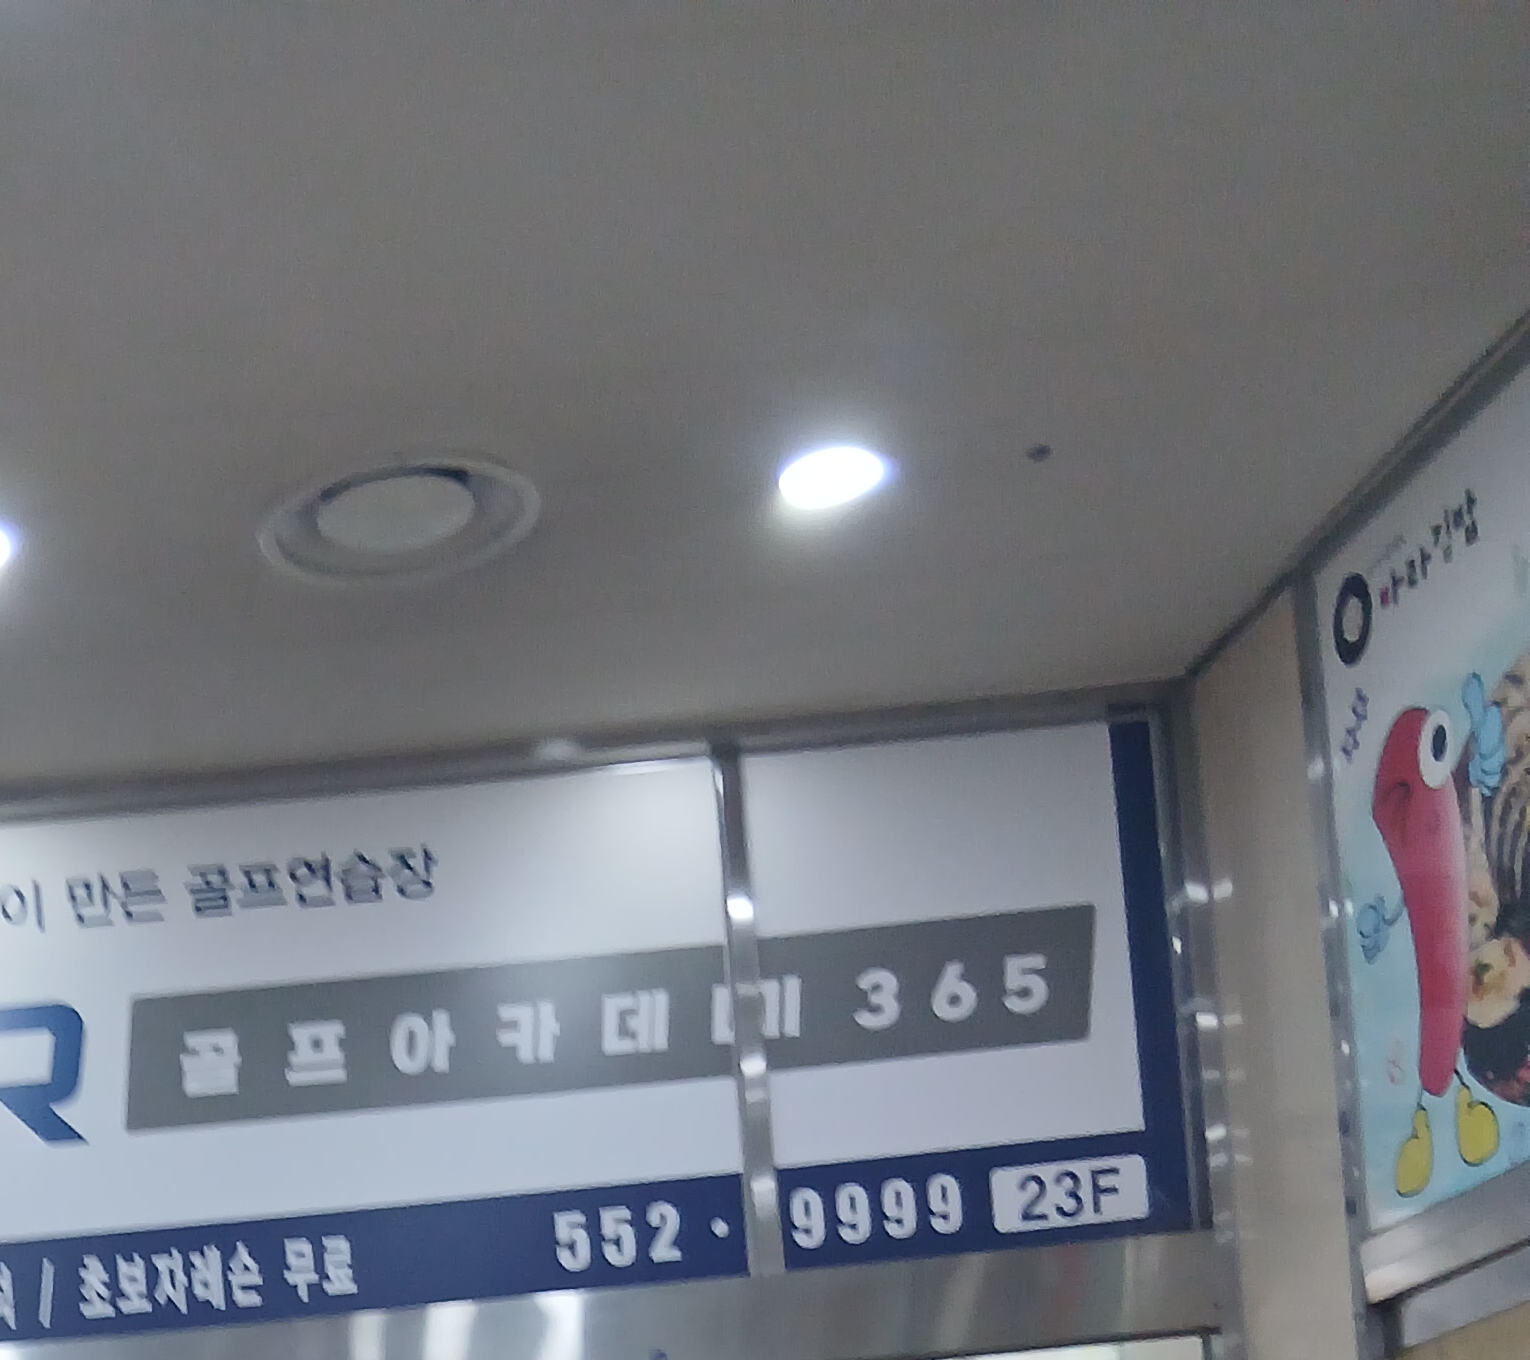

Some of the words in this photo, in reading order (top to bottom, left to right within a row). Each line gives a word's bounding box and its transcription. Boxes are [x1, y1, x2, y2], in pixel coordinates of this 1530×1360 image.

[67, 868, 166, 928] 만든
[183, 843, 438, 918] 골프연습장
[1019, 1167, 1121, 1222] 23F
[283, 1233, 358, 1302] 무료
